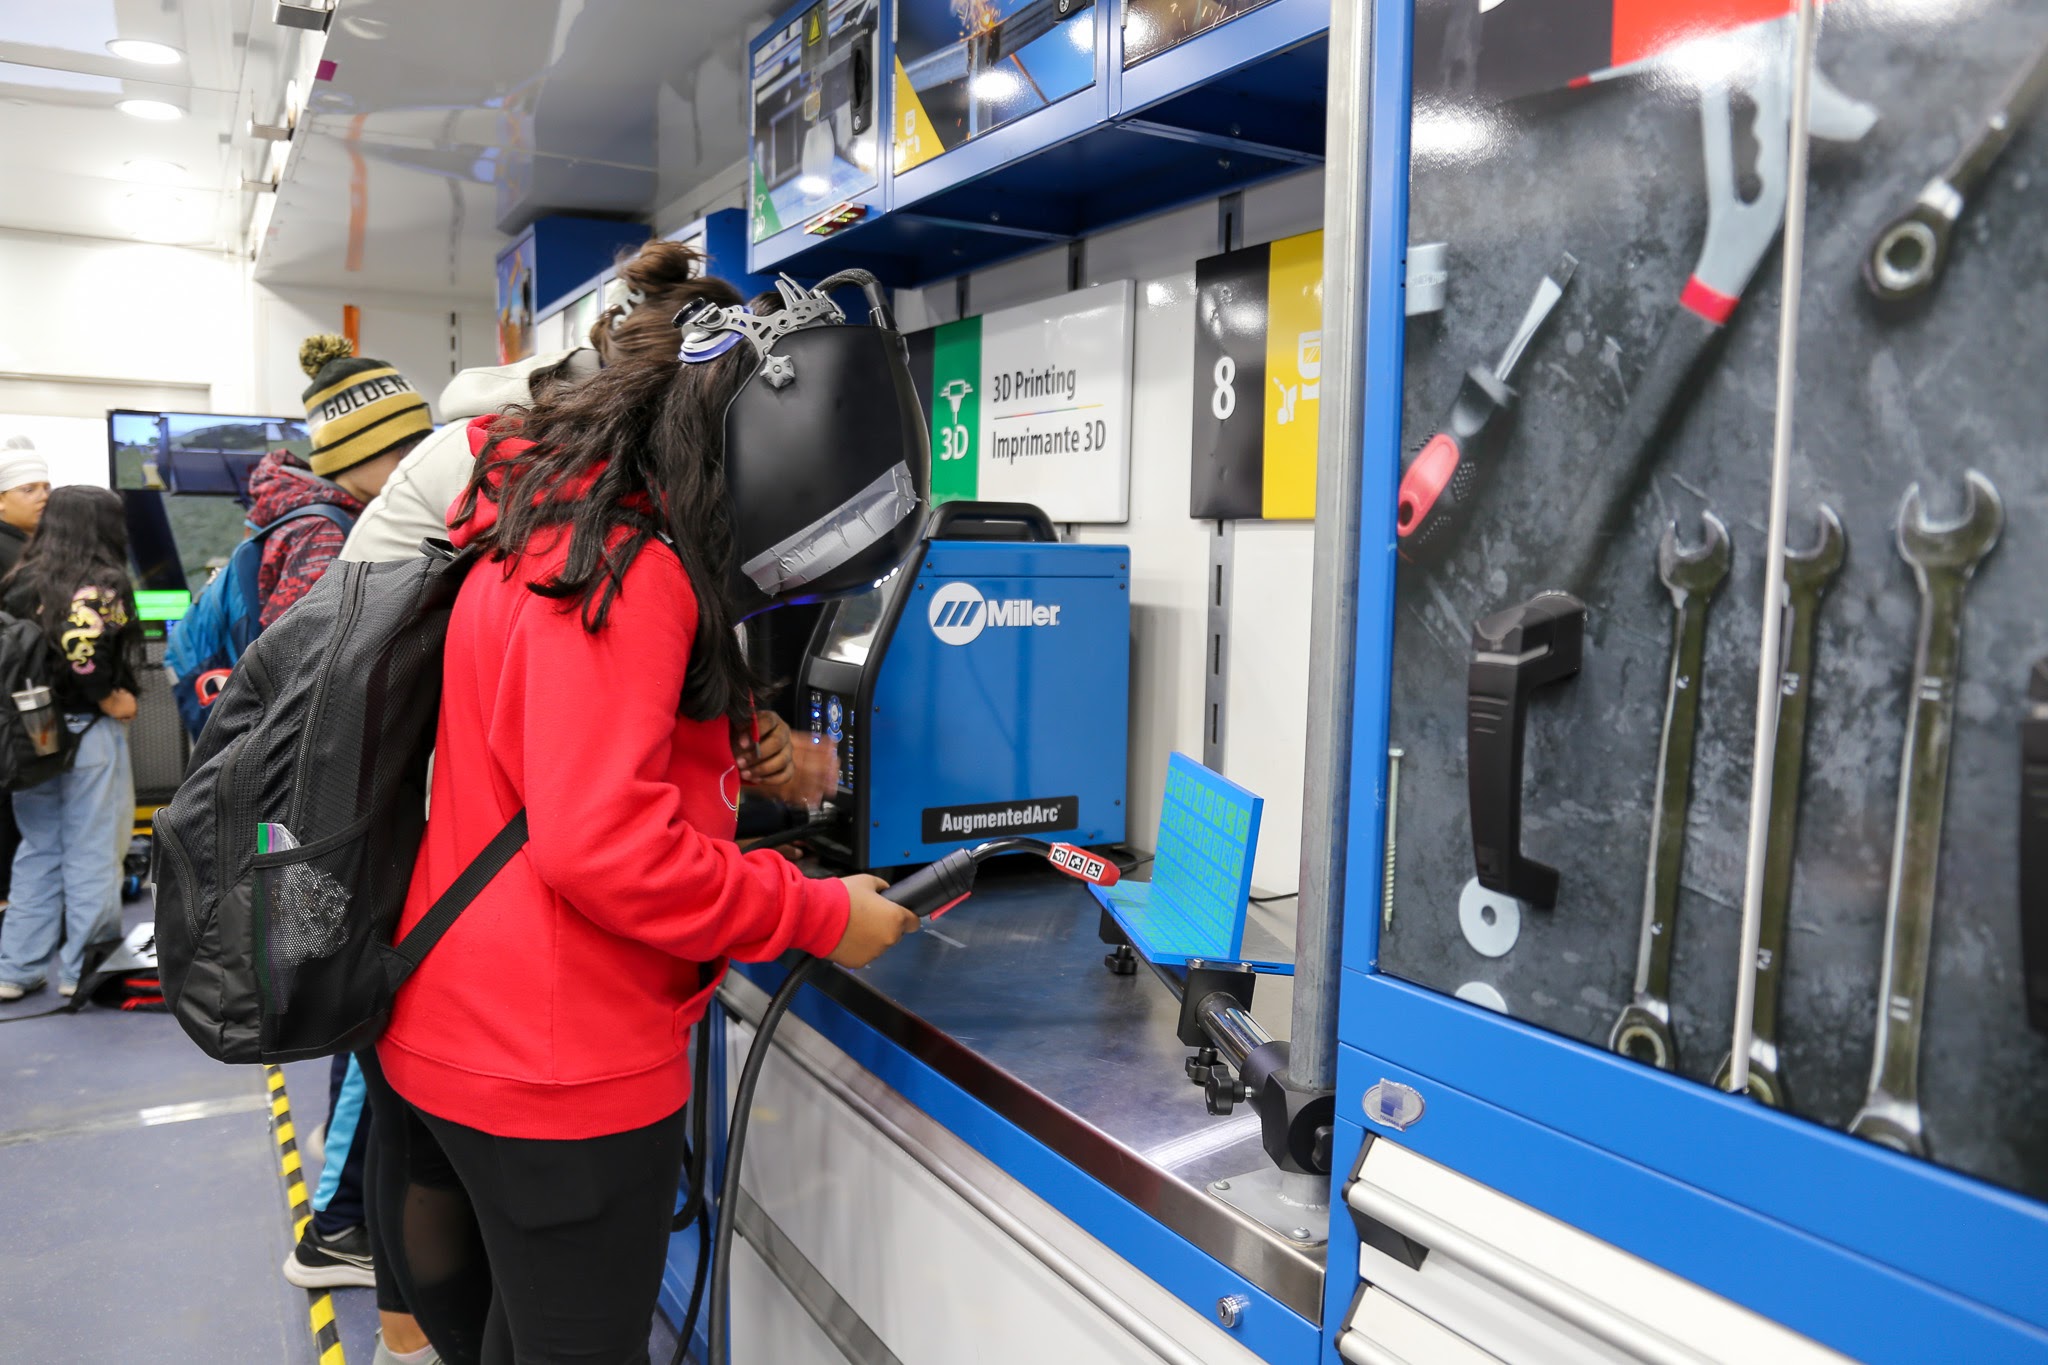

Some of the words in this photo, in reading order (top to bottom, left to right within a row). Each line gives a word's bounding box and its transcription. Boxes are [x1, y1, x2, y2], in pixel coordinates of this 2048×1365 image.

[322, 374, 410, 421] GOLDEN
[993, 373, 1011, 403] 3D
[1015, 364, 1076, 400] Printing
[1212, 355, 1236, 420] 8
[940, 424, 969, 461] 3D
[992, 427, 1080, 465] Imprimante
[1084, 419, 1106, 451] 3D
[987, 599, 1060, 627] Miller
[941, 804, 1061, 834] AugmentedArc
